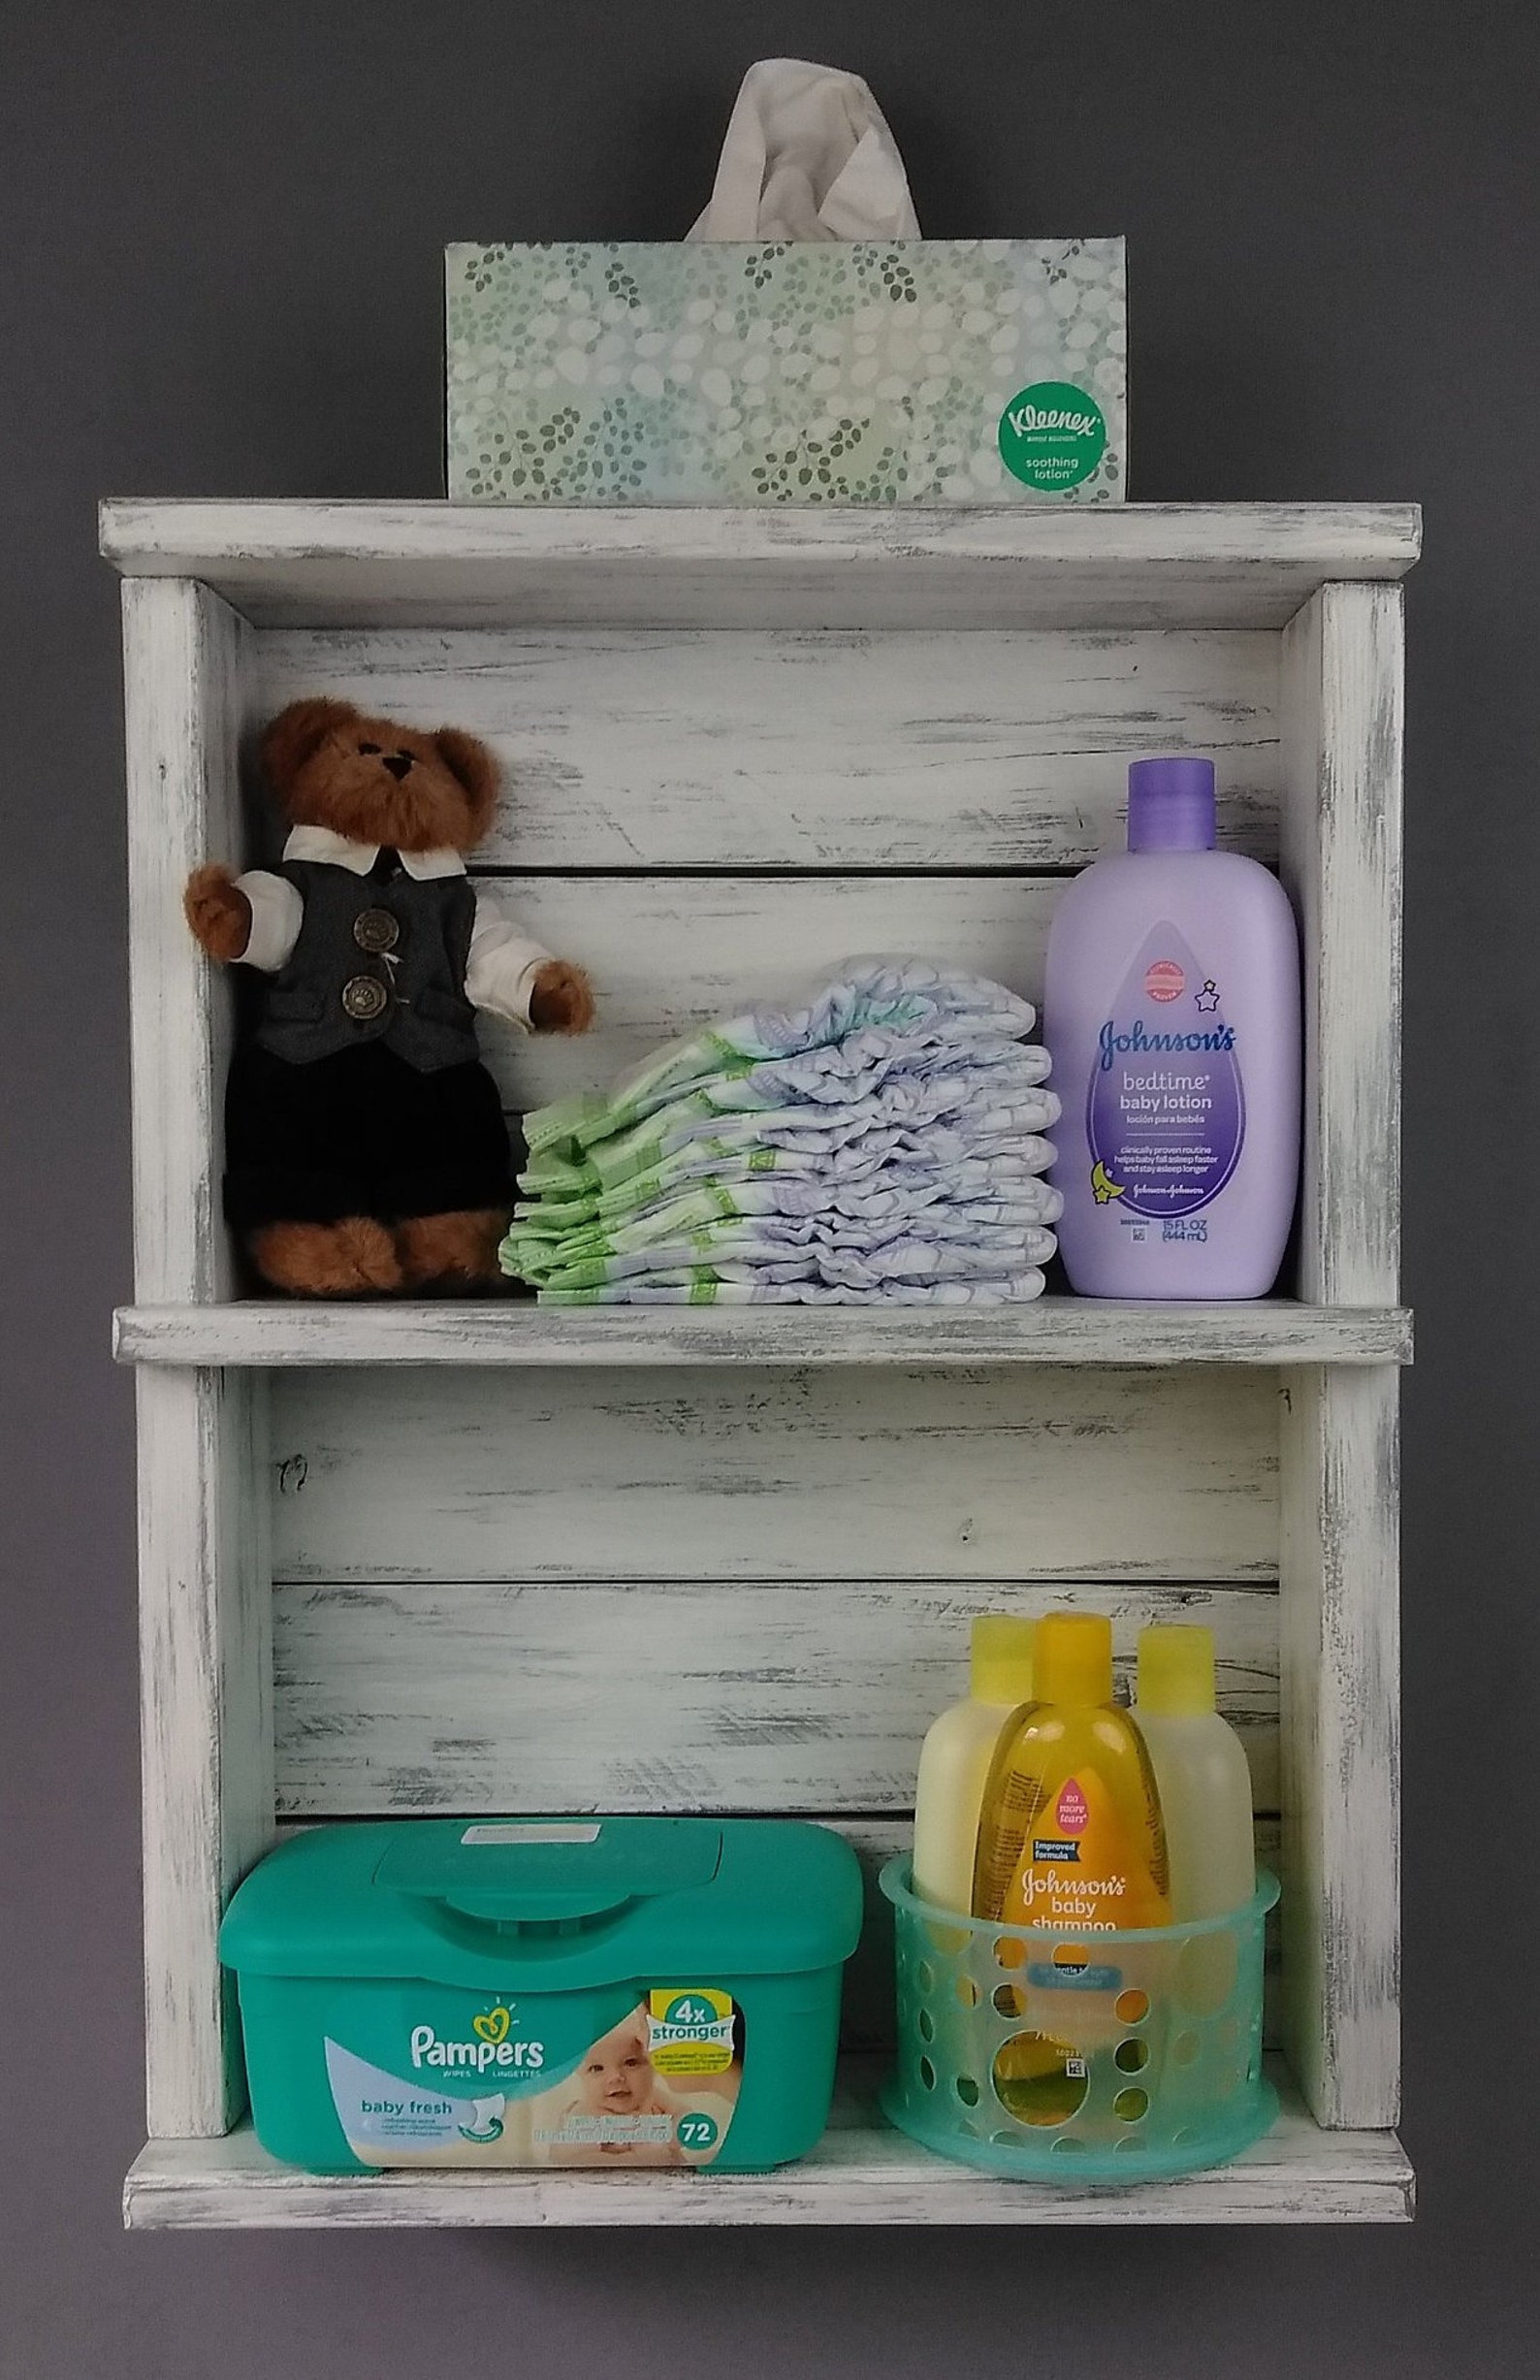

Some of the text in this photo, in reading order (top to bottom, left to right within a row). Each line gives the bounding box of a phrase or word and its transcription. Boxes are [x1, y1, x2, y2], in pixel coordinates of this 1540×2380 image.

[1009, 404, 1097, 437] Kleenex
[1026, 457, 1079, 468] soothing
[1035, 468, 1070, 479] lotion
[1099, 1020, 1236, 1071] Johnson's
[1120, 1094, 1212, 1112] baby lotion
[1155, 1116, 1175, 1125] para
[1154, 1146, 1182, 1155] proven
[1182, 1145, 1212, 1154] routine
[1164, 1219, 1174, 1231] 15
[1175, 1219, 1188, 1231] FL
[1190, 1219, 1207, 1231] OZ
[1066, 1794, 1078, 1803] no
[1059, 1805, 1085, 1814] more
[1035, 1841, 1075, 1851] Improved
[1035, 1850, 1069, 1860] formula
[1022, 1868, 1126, 1907] Johnson's
[1052, 1897, 1097, 1917] baby
[675, 2000, 706, 2024] 4x
[652, 2025, 728, 2042] stronger
[411, 2025, 545, 2073] Pampers
[443, 2069, 542, 2078] WIPES LINGETTES
[361, 2099, 453, 2116] baby fresh
[681, 2123, 711, 2141] 72
